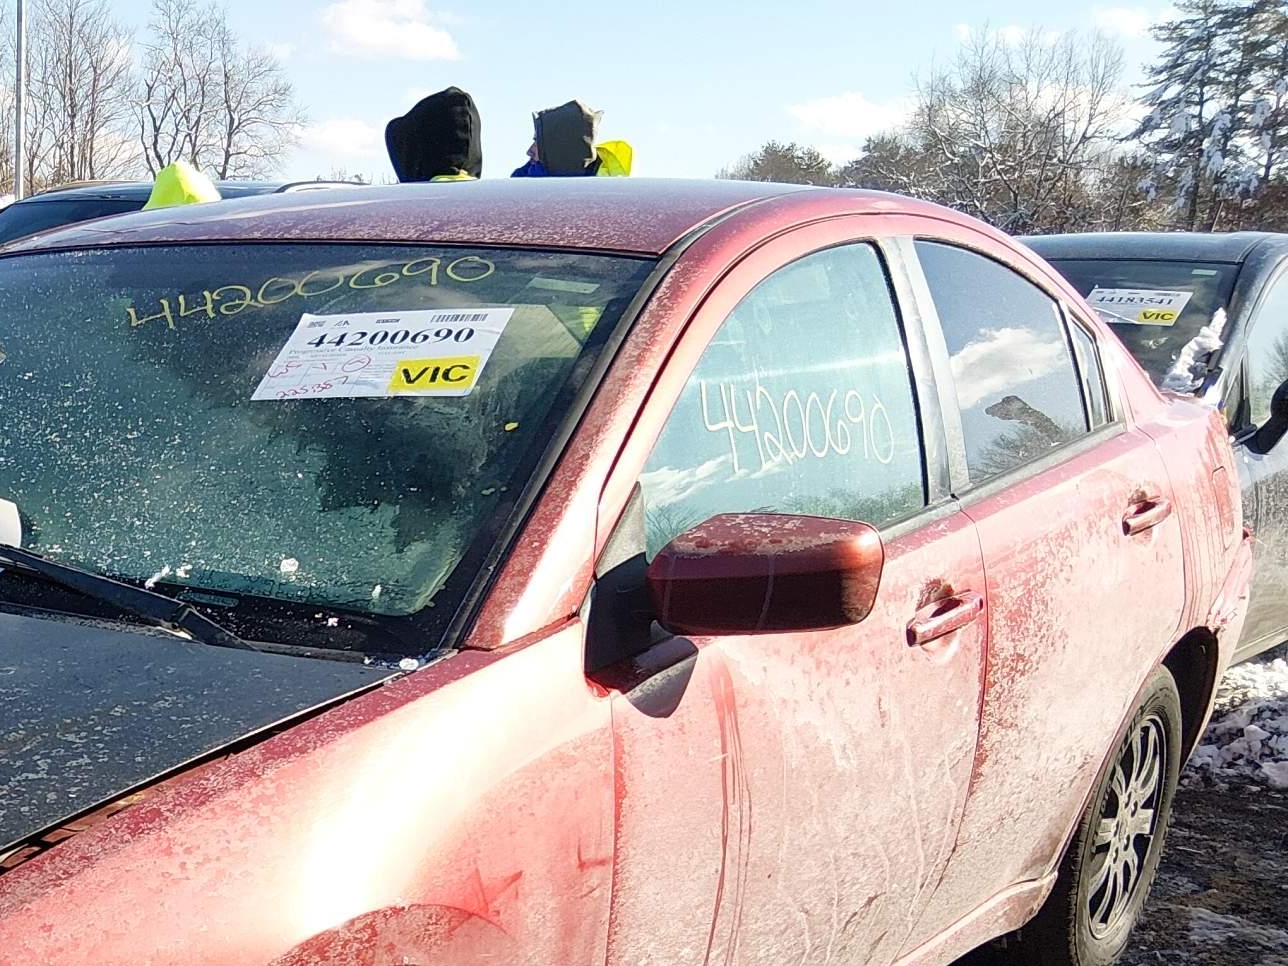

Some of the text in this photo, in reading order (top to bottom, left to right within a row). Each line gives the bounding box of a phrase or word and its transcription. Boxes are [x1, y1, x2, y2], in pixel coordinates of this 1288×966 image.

[126, 255, 495, 329] 44200690
[1142, 310, 1174, 321] VIC
[307, 327, 475, 348] 44200690
[402, 364, 471, 385] VIC
[701, 372, 894, 473] 44200690
